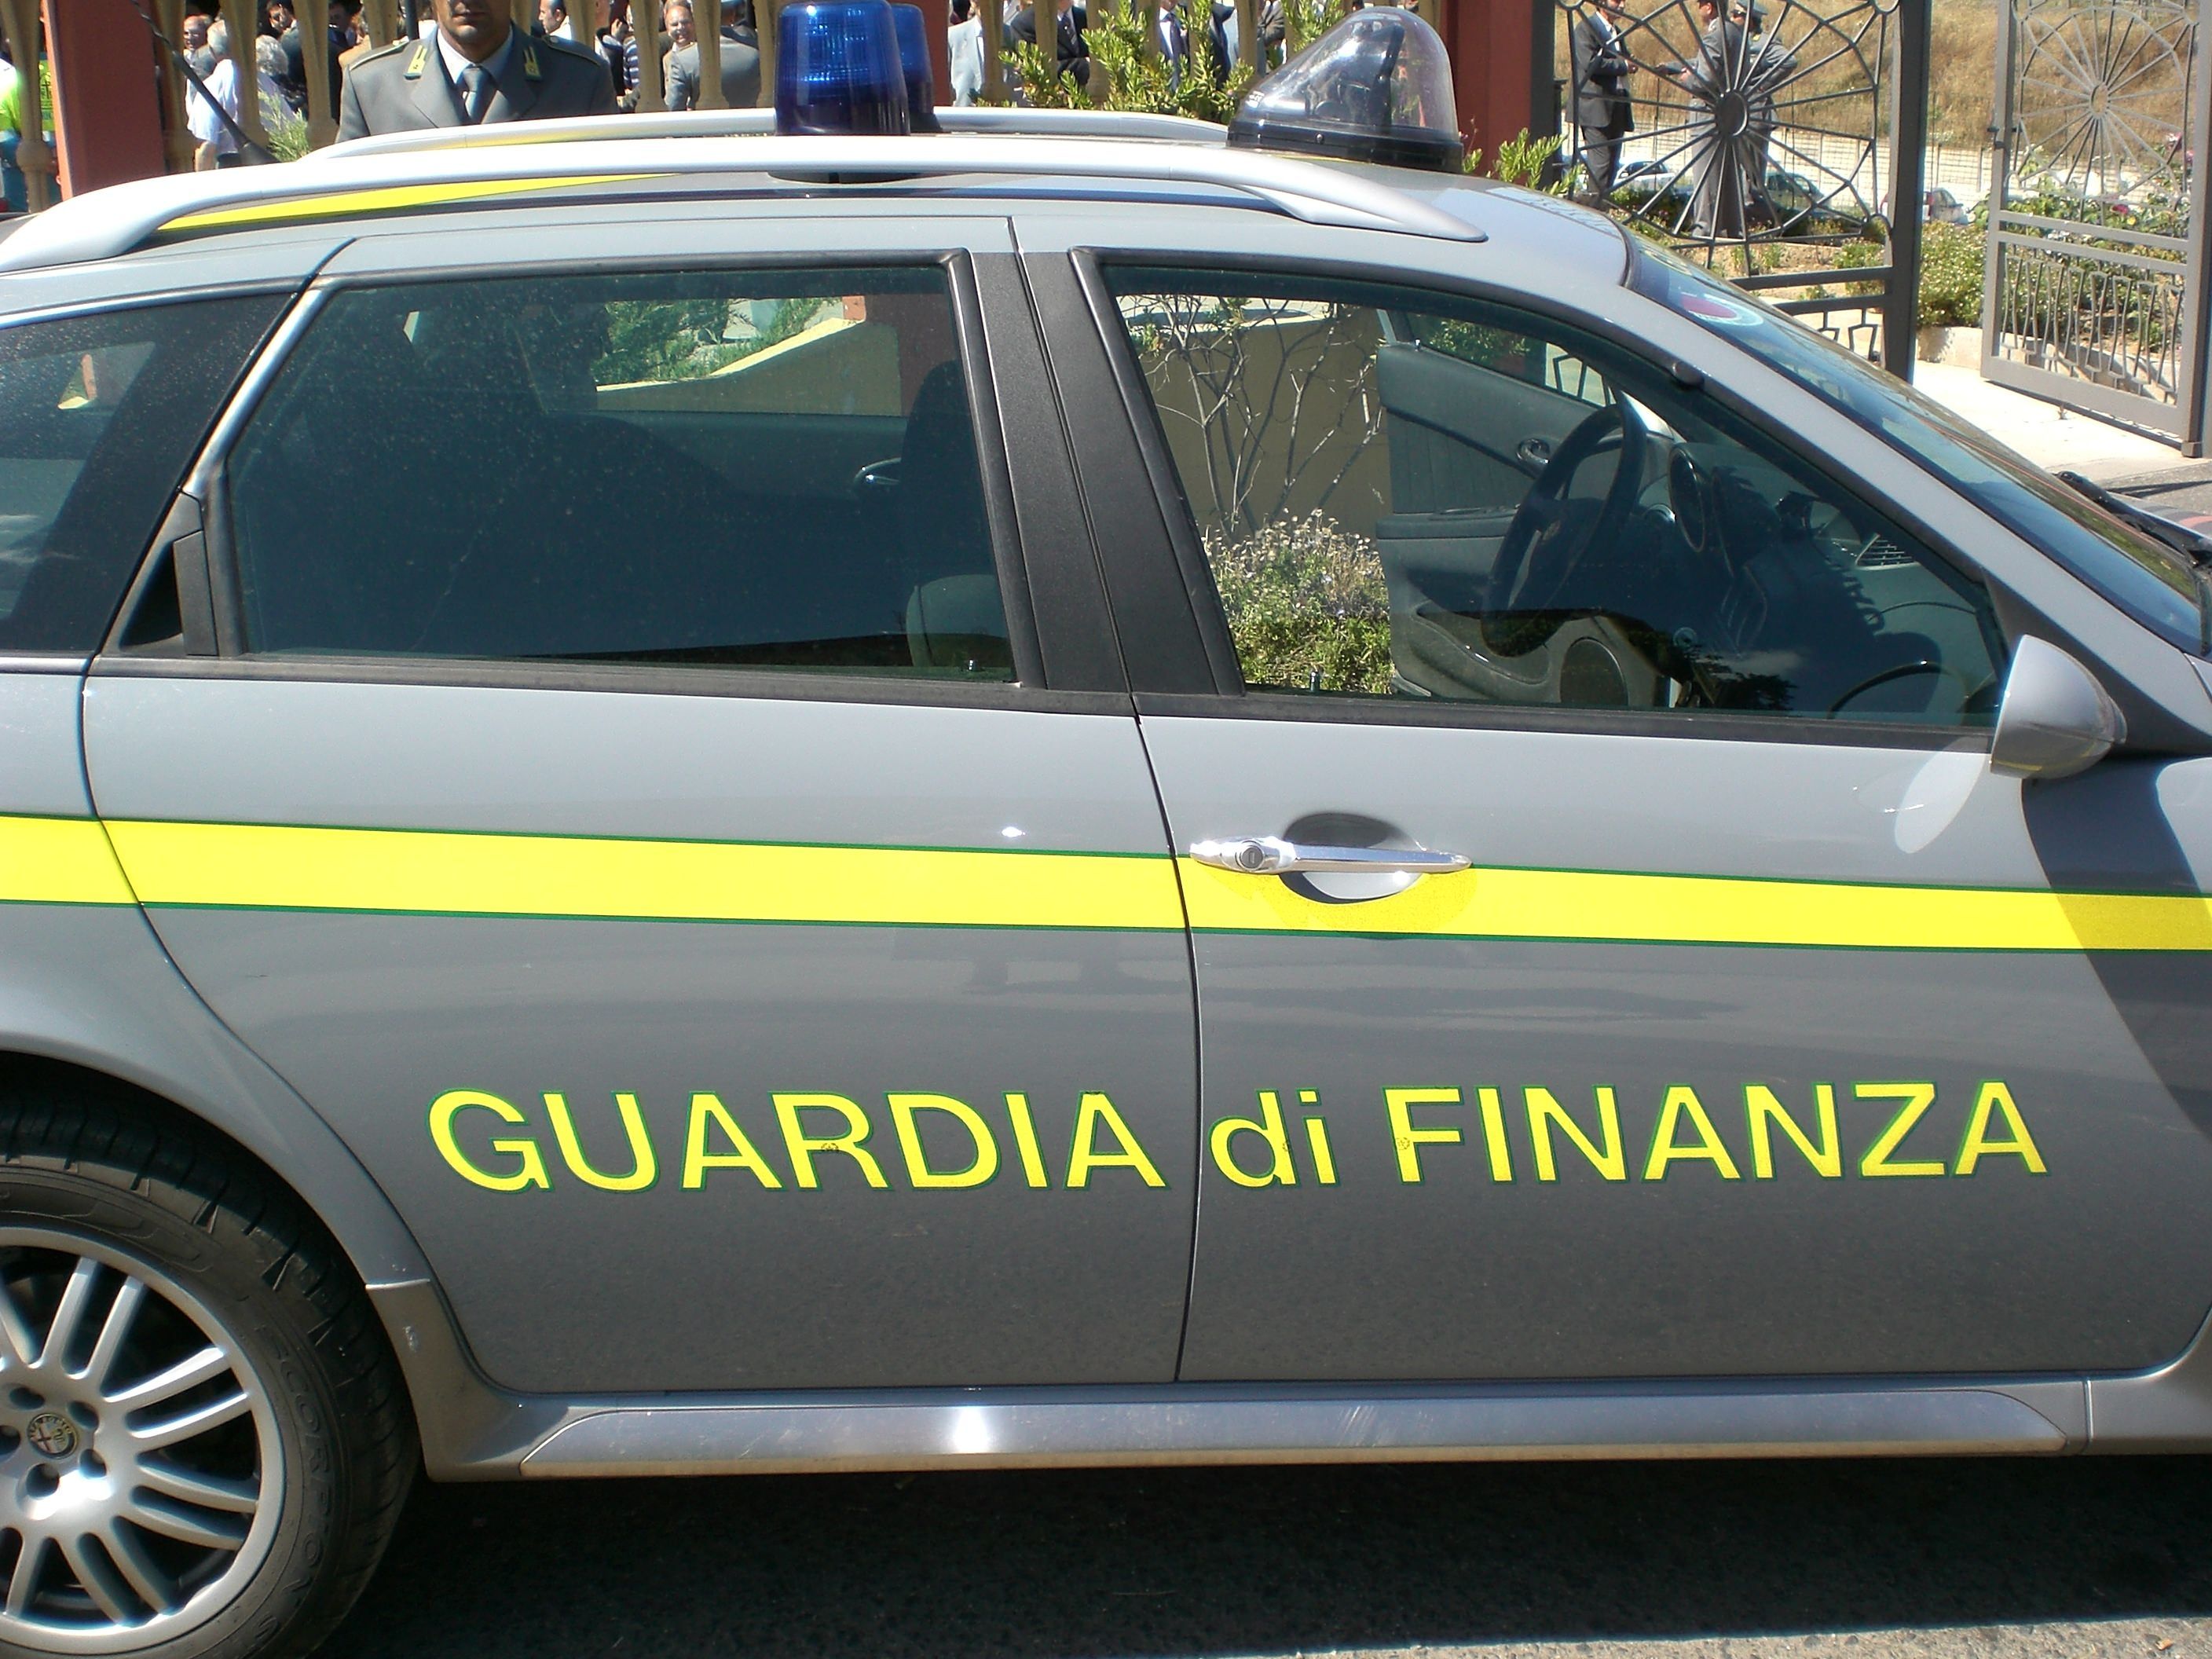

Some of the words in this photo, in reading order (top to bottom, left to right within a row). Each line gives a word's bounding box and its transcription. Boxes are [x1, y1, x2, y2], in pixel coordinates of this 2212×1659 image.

[426, 1088, 1168, 1194] GUARDIA
[1208, 1088, 1339, 1187] di
[1382, 1080, 2049, 1185] FINANZA
